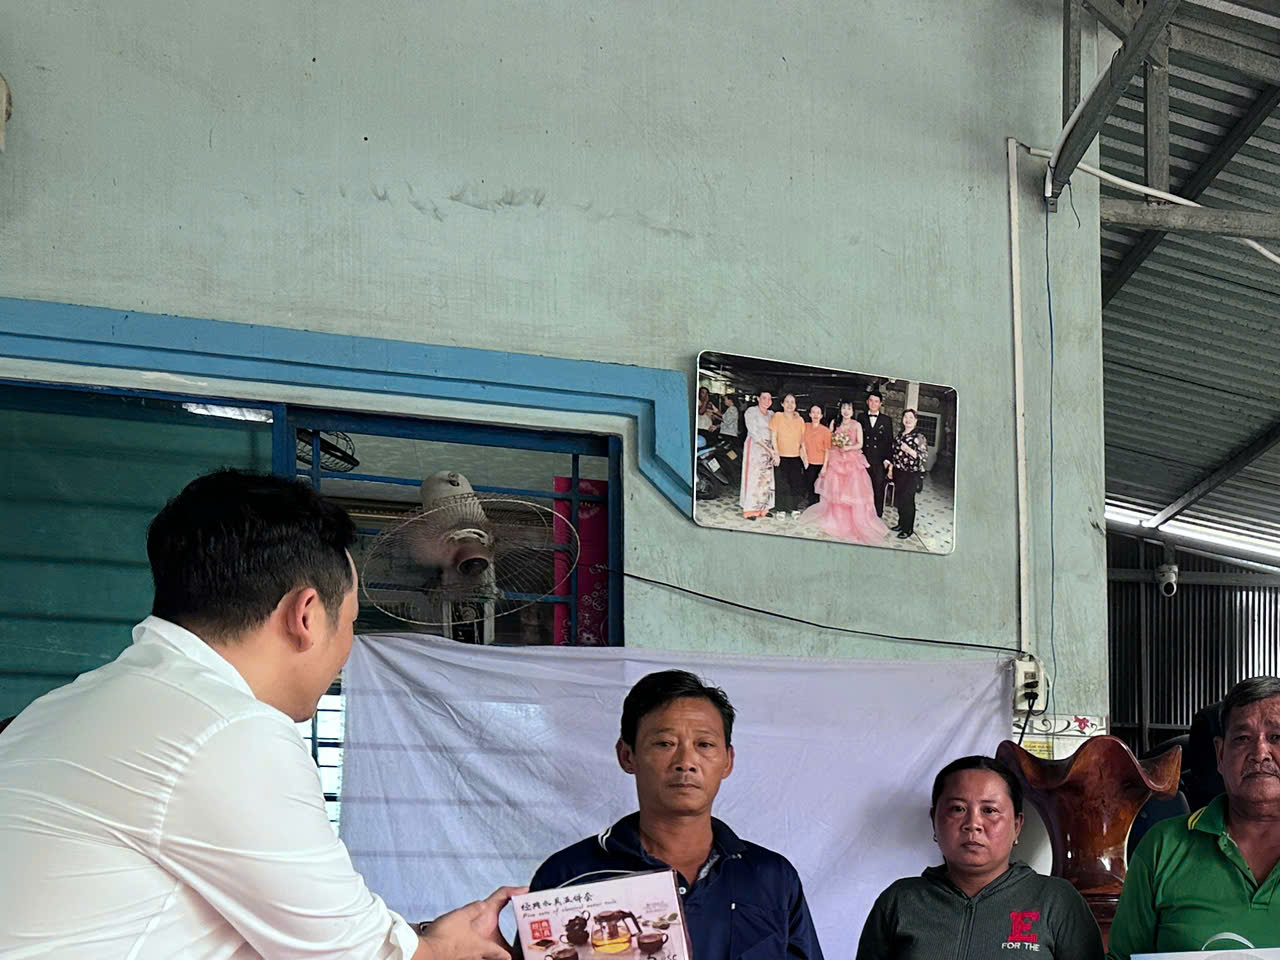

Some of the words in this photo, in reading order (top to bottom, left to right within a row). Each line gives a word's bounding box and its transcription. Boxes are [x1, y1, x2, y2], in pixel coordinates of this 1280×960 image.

[1008, 911, 1040, 944] E
[1001, 942, 1021, 950] FOR
[1023, 942, 1040, 952] THE
